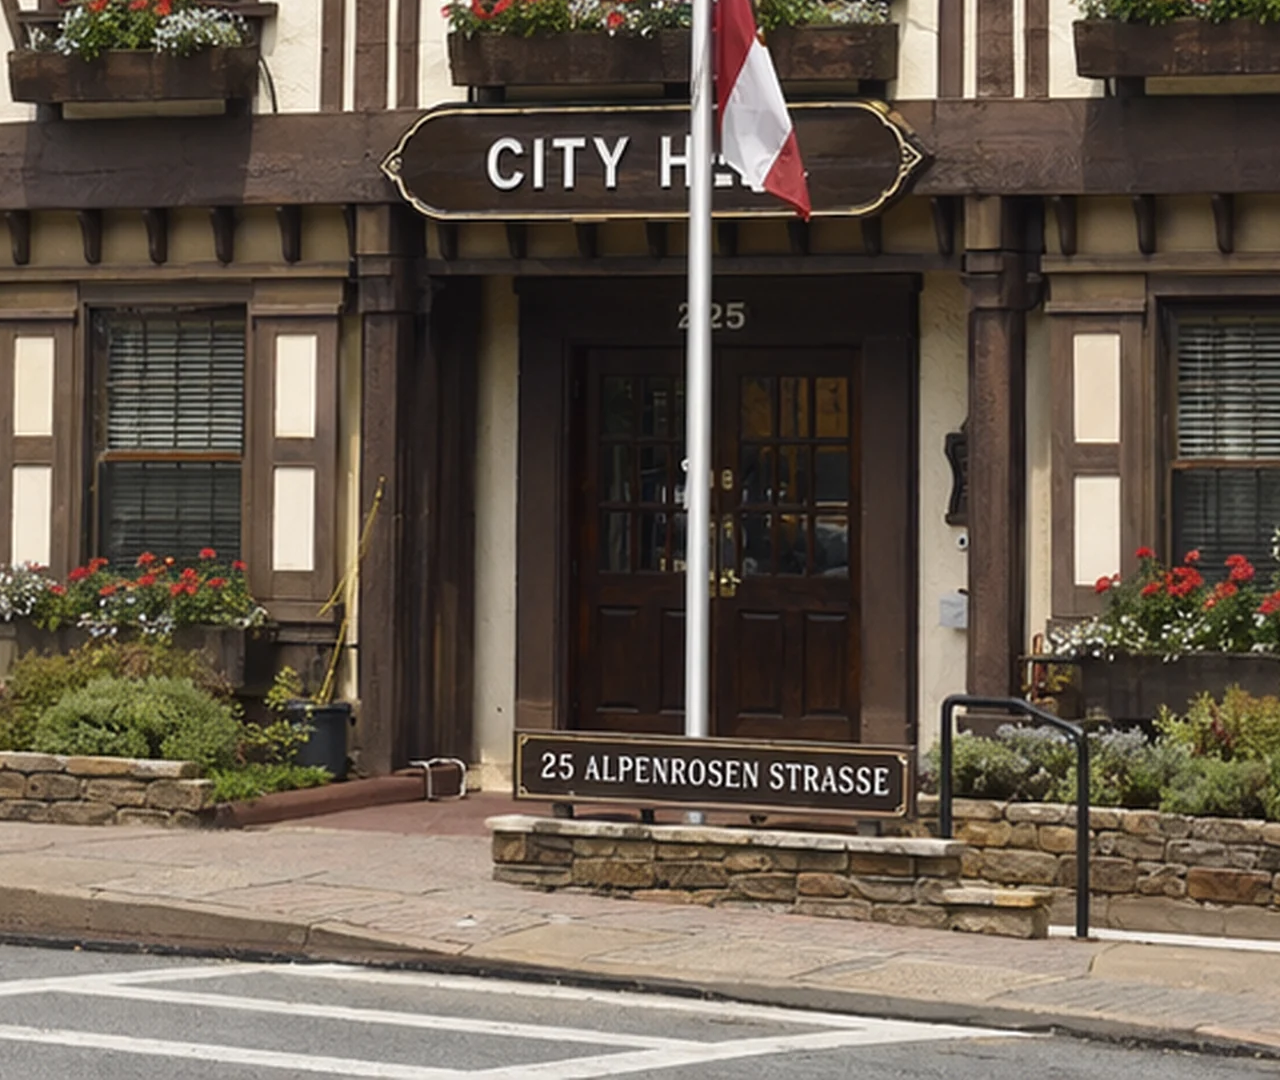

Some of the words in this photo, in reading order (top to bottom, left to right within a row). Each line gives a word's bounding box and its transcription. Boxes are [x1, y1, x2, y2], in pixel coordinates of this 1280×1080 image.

[487, 137, 628, 189] CITY
[541, 752, 574, 780] 25
[585, 756, 758, 788] ALPENROSEN
[771, 762, 889, 796] STRASSE
